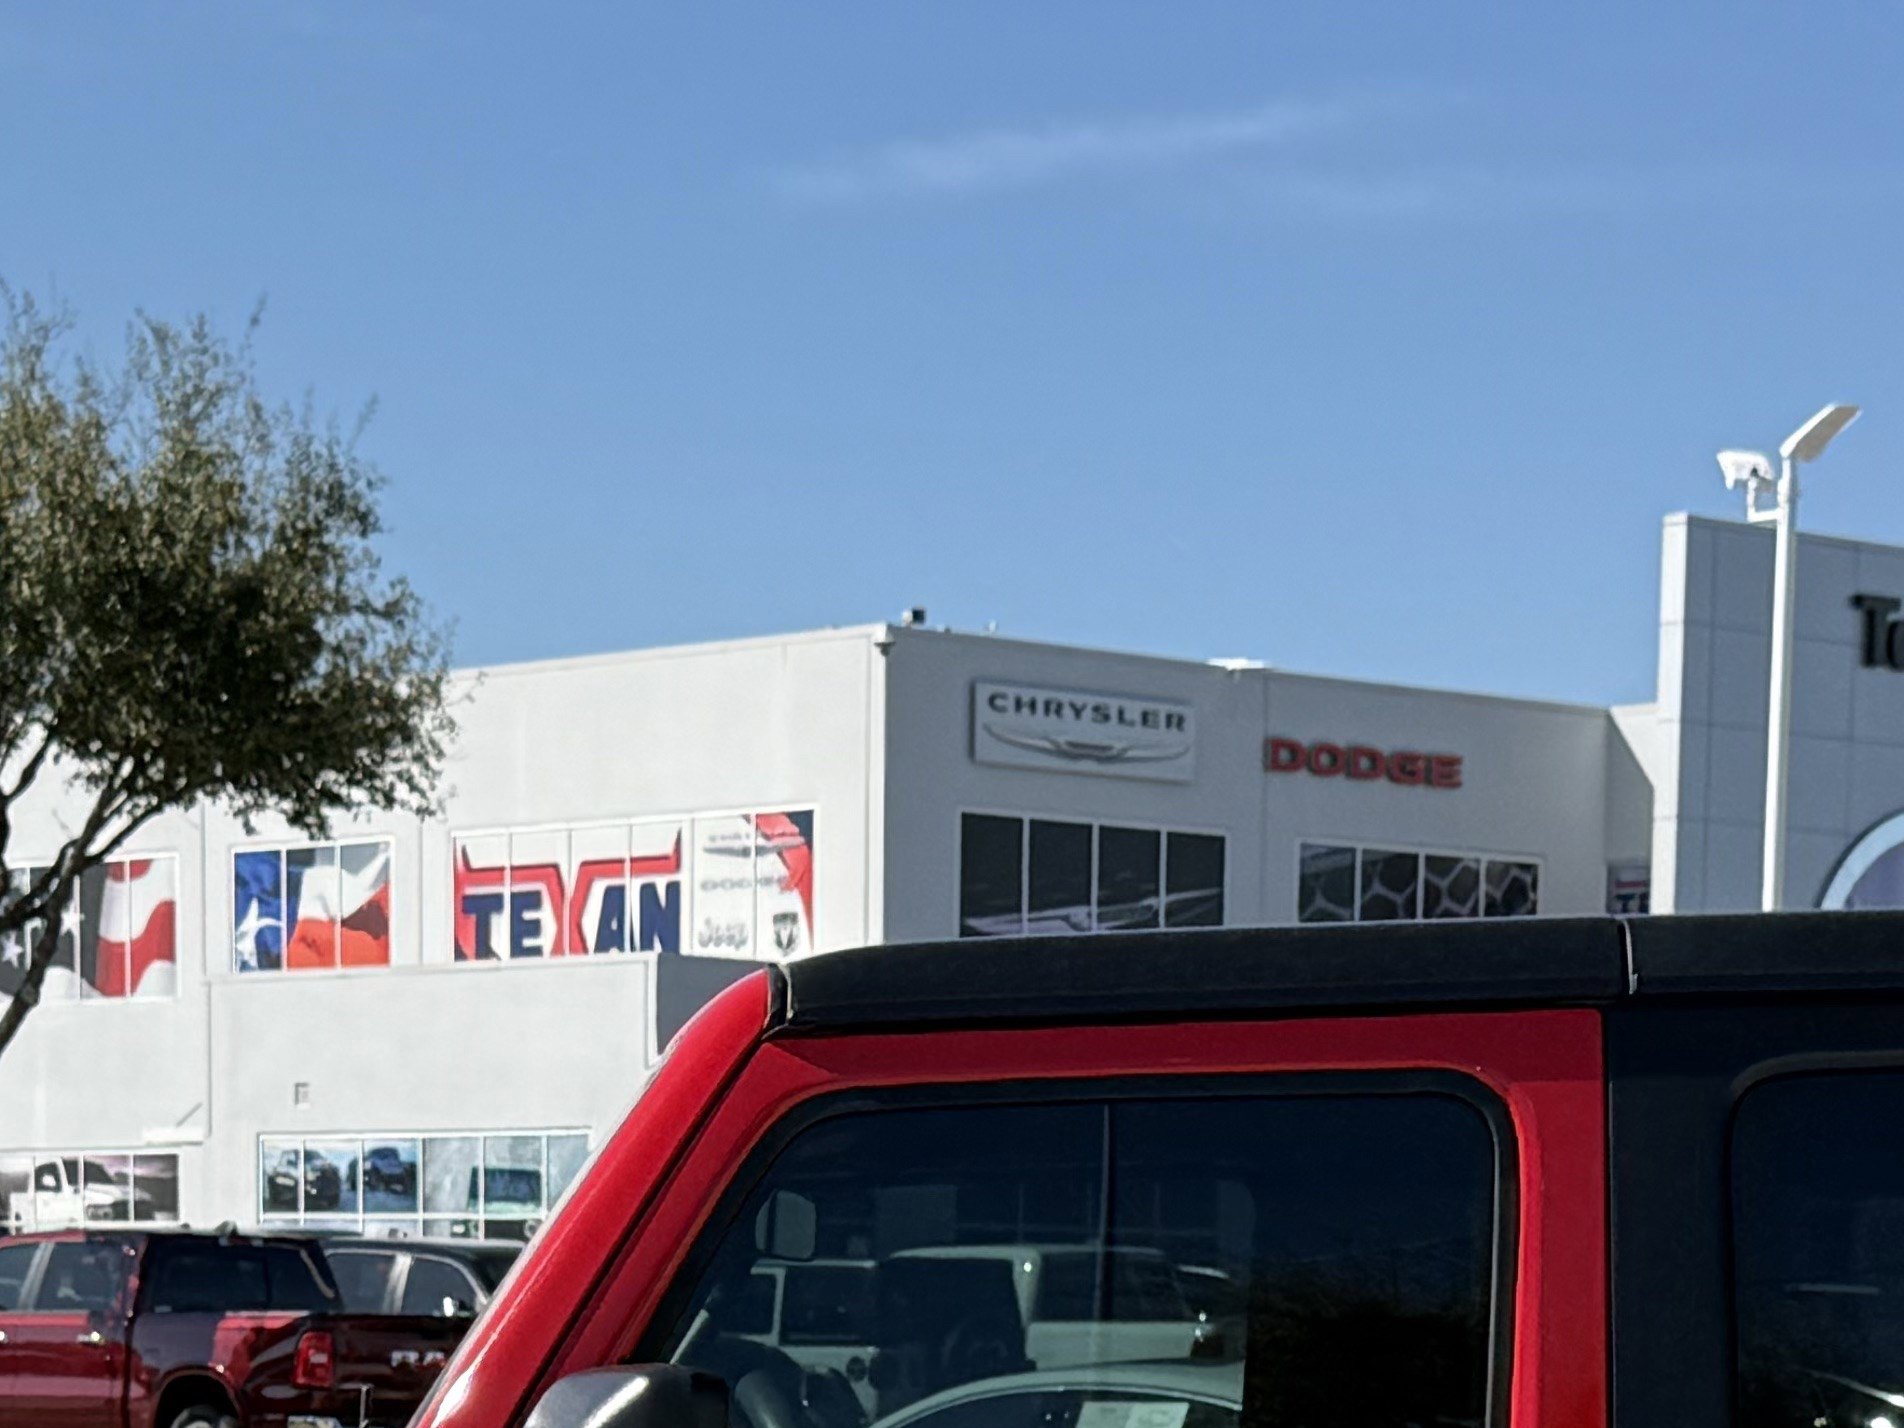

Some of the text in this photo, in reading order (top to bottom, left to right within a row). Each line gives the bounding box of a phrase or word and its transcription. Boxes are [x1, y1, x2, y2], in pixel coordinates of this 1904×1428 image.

[987, 691, 1187, 733] CHRYSLER
[1265, 736, 1463, 789] DODGE
[454, 845, 682, 958] TEXAN
